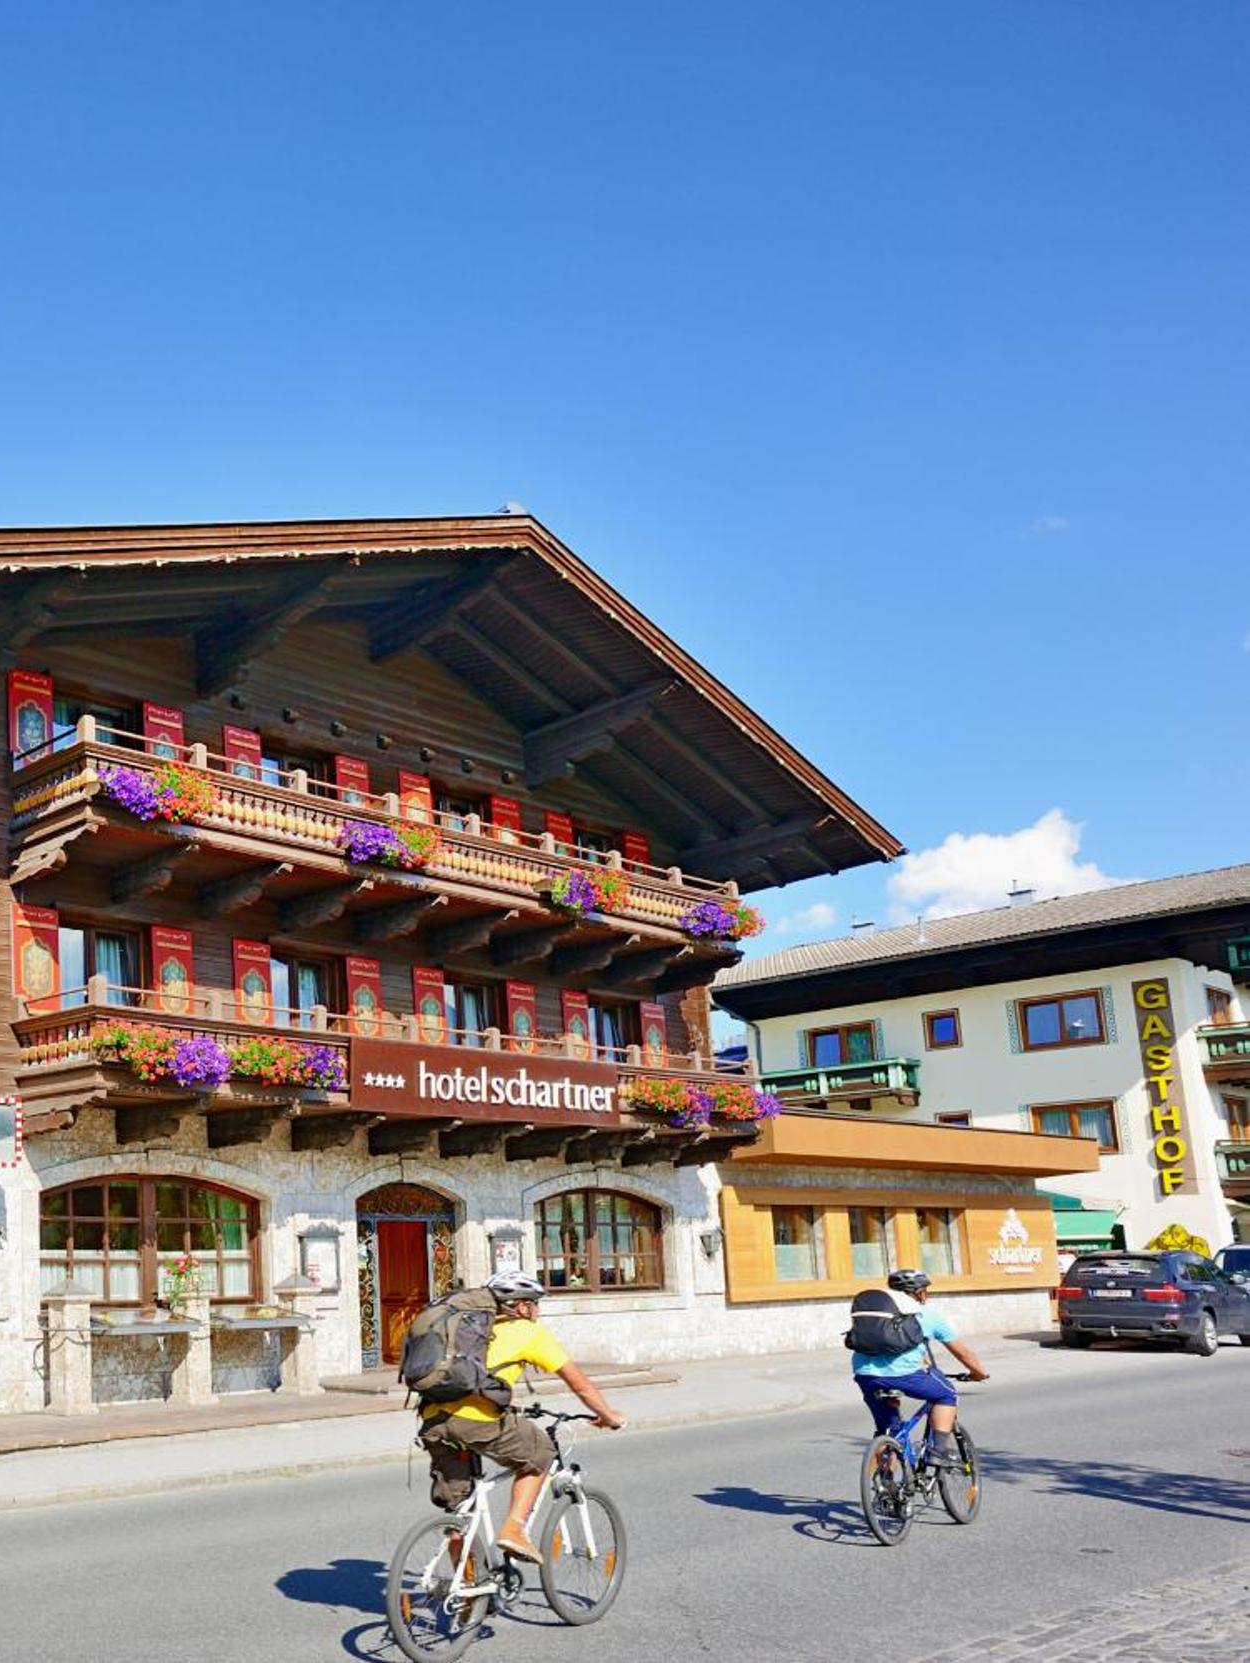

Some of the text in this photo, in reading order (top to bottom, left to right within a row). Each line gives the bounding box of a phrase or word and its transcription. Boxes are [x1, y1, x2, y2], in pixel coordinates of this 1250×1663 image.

[419, 1060, 616, 1111] hotel schartner
[1136, 981, 1187, 1194] GASTHOF
